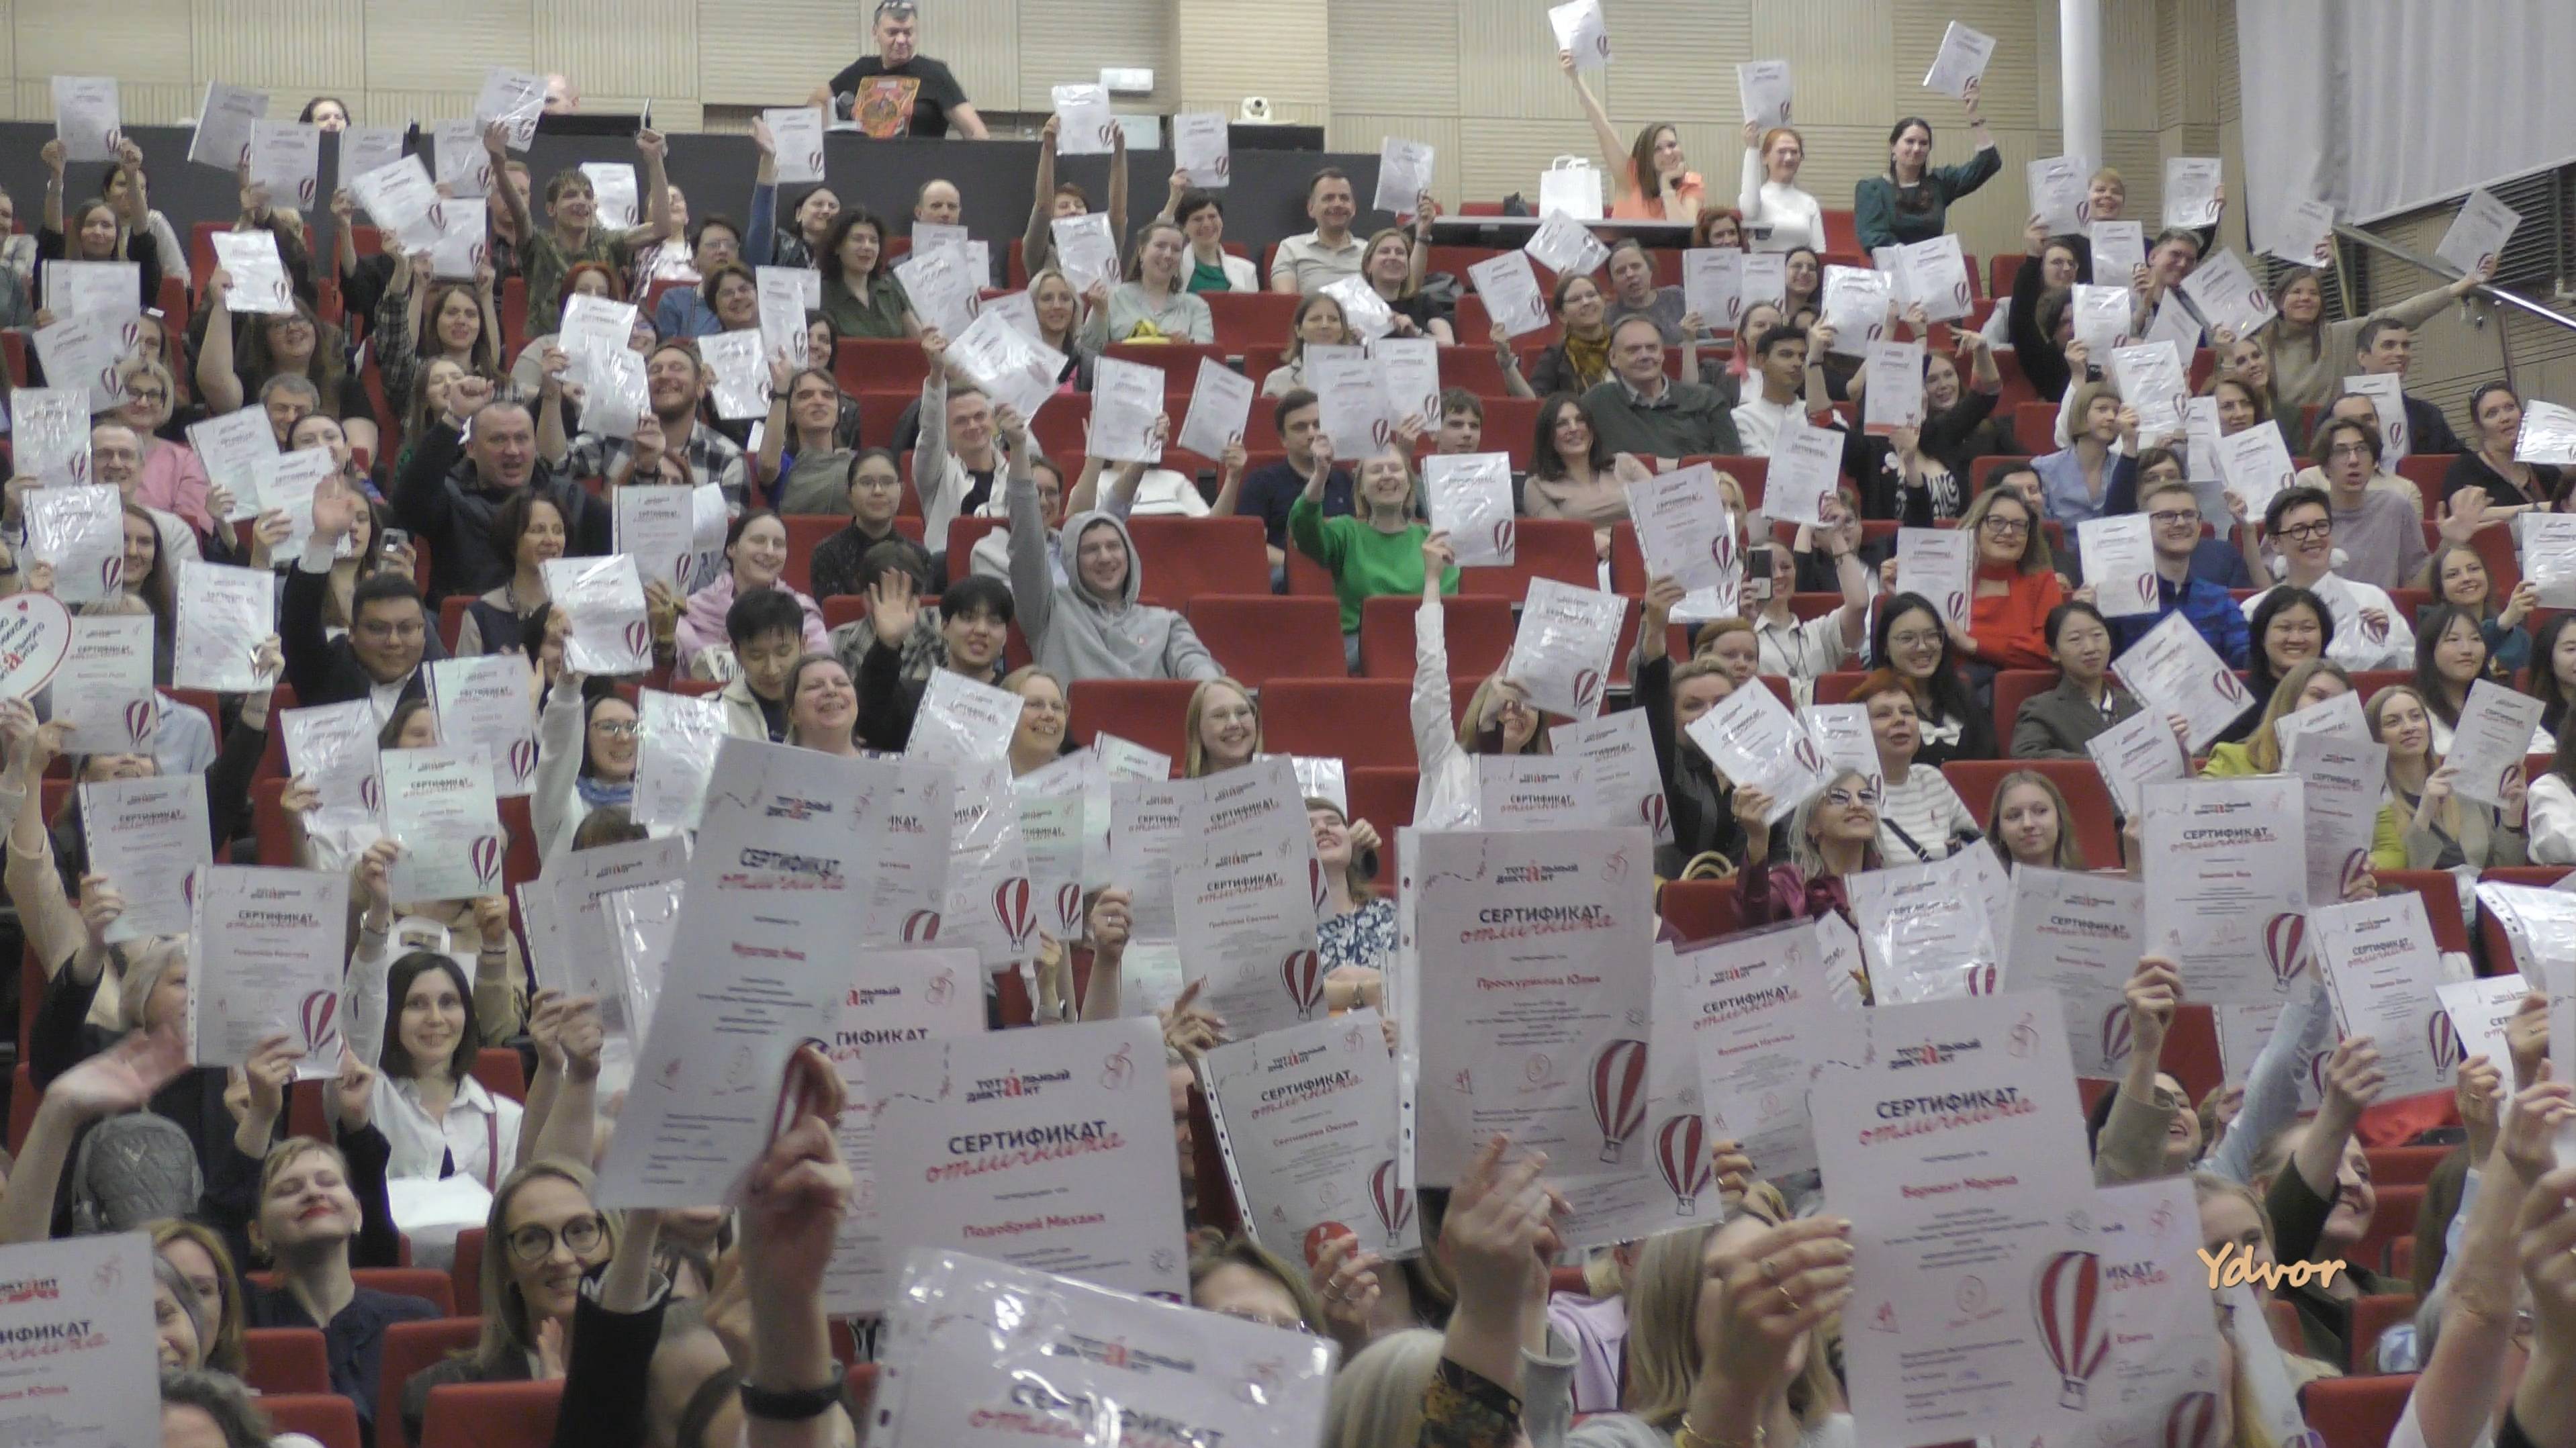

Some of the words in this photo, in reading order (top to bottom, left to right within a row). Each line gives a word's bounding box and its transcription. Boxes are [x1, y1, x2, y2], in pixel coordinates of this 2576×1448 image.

[2184, 827, 2267, 840] СЕРТИФИКАТ
[1479, 905, 1602, 924] СЕРТИФИКАТ
[1703, 985, 1789, 1014] СЕРТИФИКАТ
[836, 1028, 928, 1046] ТИФИКАТ
[1261, 1069, 1350, 1102] СЕРТИФИКАТ
[1876, 1087, 2017, 1119] СЕРТИФИКАТ
[948, 1120, 1107, 1155] СЕРТИФИКАТ
[0, 1320, 93, 1345] ИФИКАТ
